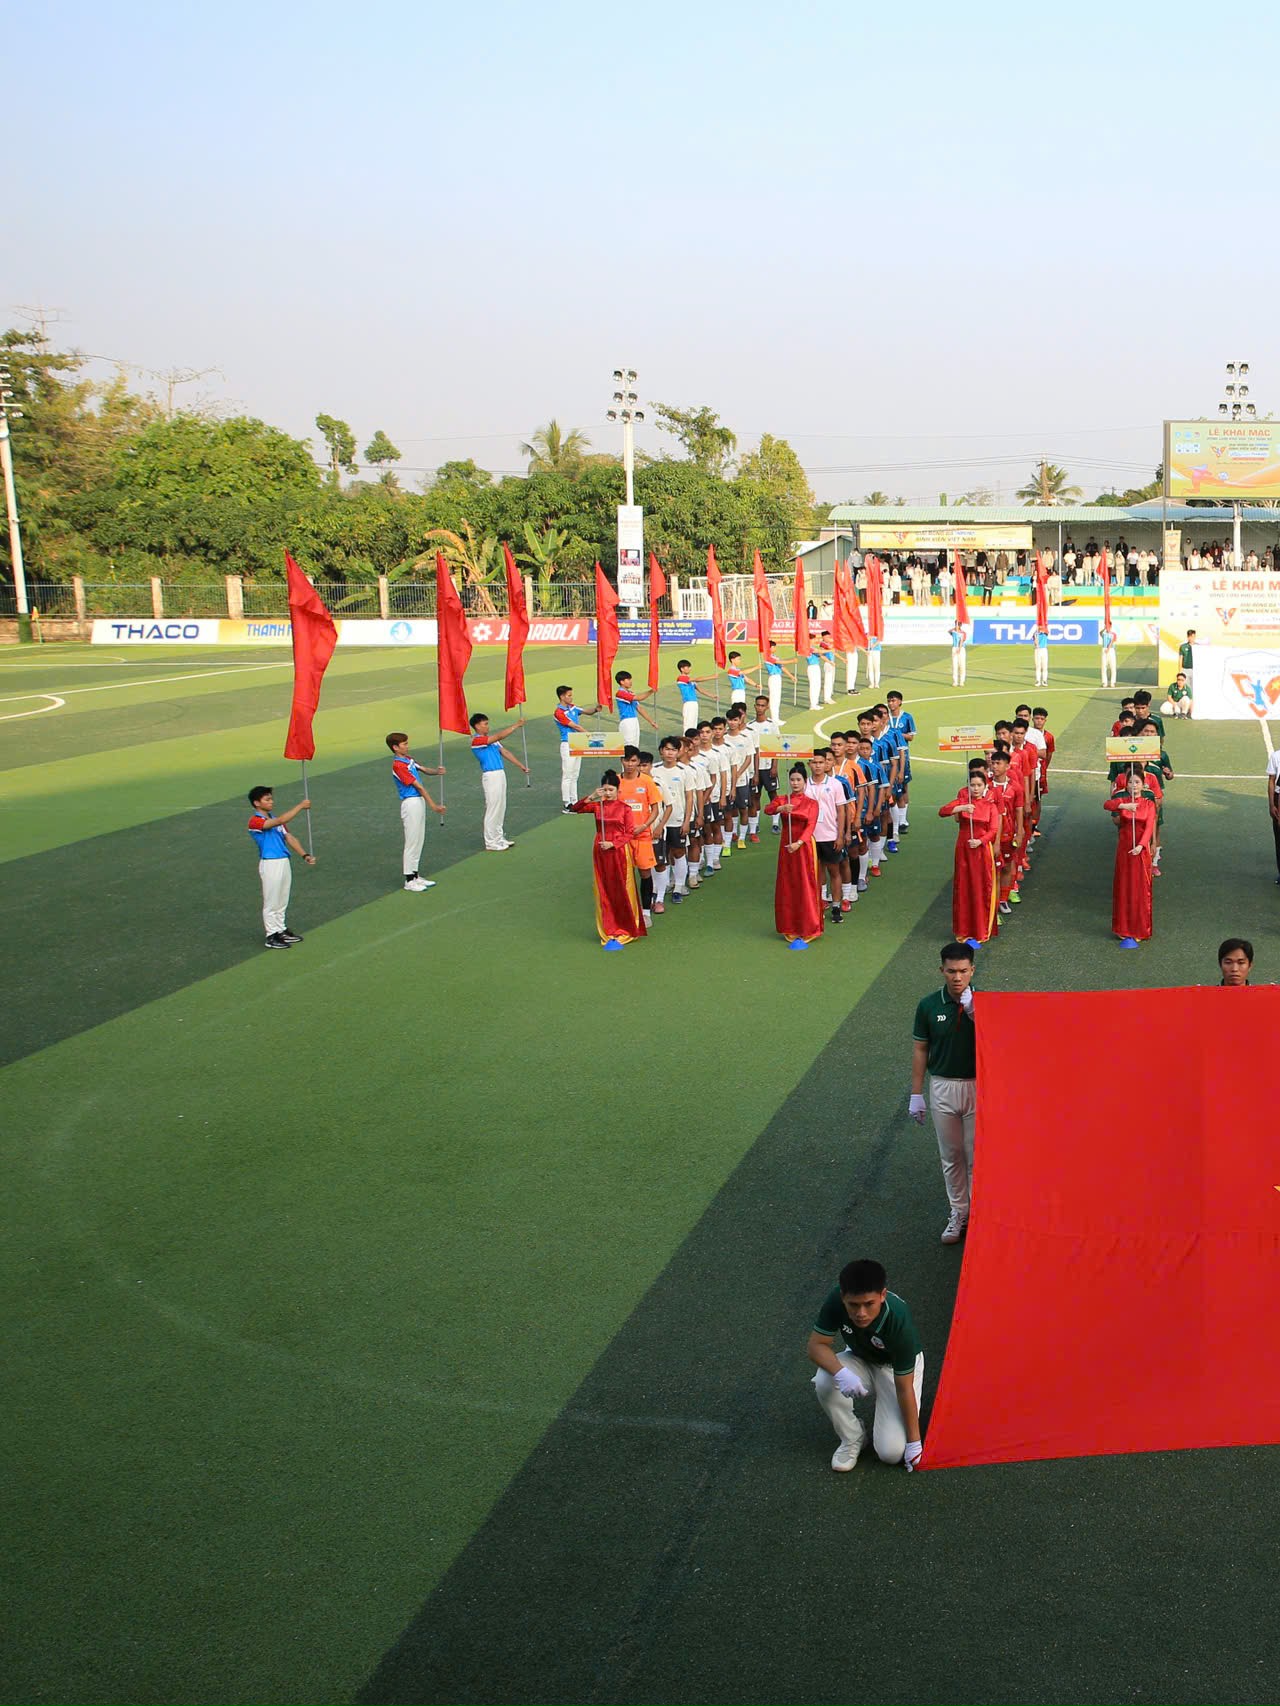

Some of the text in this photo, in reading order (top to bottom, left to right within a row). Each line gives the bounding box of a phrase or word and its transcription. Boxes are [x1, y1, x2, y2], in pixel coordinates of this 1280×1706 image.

[1232, 580, 1264, 591] KHAI
[111, 624, 200, 640] THACO
[247, 623, 286, 637] THANH
